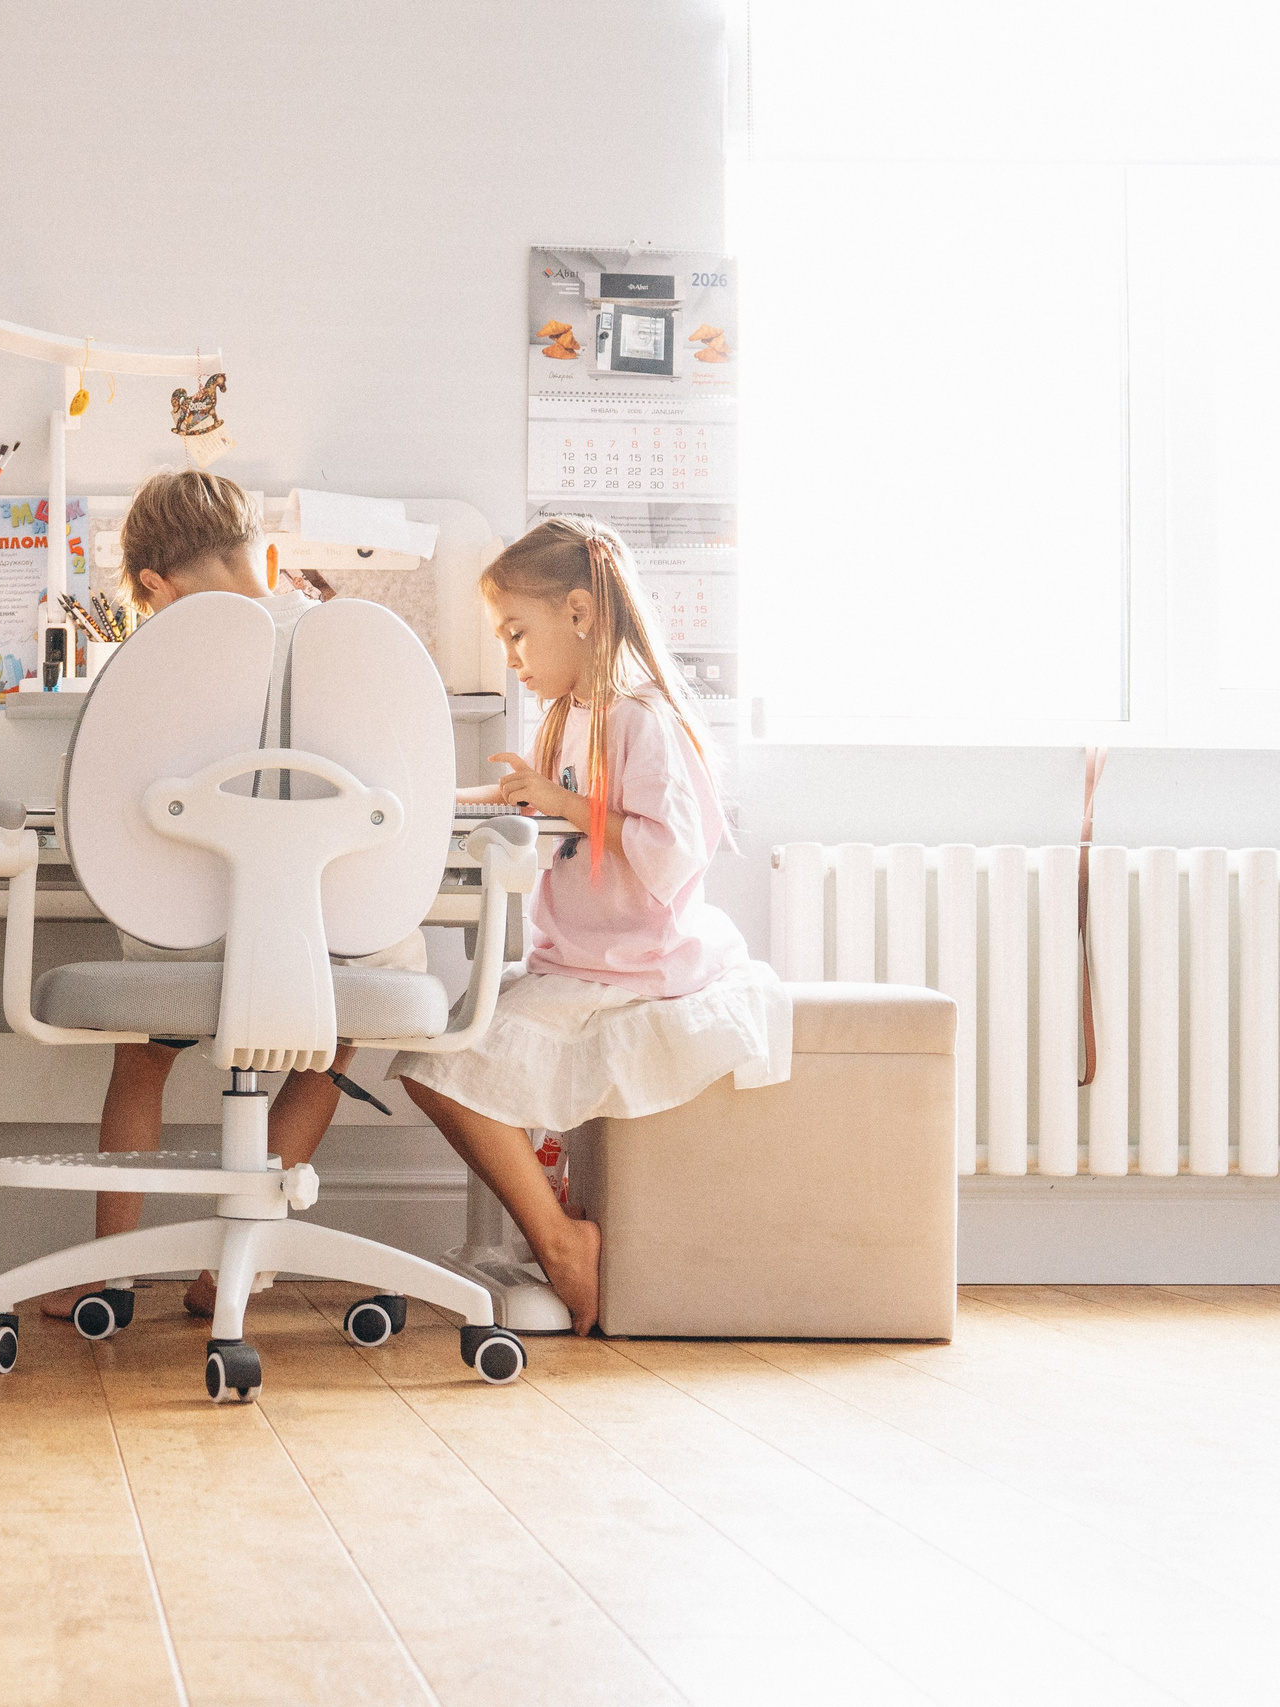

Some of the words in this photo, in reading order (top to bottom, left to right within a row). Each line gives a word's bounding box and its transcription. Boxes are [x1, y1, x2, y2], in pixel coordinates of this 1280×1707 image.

[691, 272, 727, 287] 2026
[564, 439, 571, 447] 5
[587, 439, 593, 447] 6
[631, 440, 638, 448] 8
[653, 440, 660, 448] 9
[673, 441, 686, 449] 10
[695, 441, 706, 449] 11
[562, 452, 575, 460] 12
[606, 453, 619, 461] 14
[651, 454, 663, 462] 16
[583, 466, 597, 474] 20
[627, 467, 641, 475] 22
[650, 467, 663, 475] 23
[694, 468, 708, 476] 25
[561, 479, 574, 487] 26
[583, 479, 596, 487] 27
[605, 480, 619, 488] 28
[650, 481, 664, 489] 30
[672, 481, 684, 489] 31
[10, 502, 34, 527] М
[68, 537, 84, 557] 5
[73, 556, 86, 574] 2
[697, 577, 702, 586] 1
[651, 591, 658, 599] 6
[674, 591, 681, 599] 7
[671, 605, 684, 613] 14
[694, 605, 707, 613] 15
[670, 618, 683, 626] 21
[670, 632, 684, 640] 28
